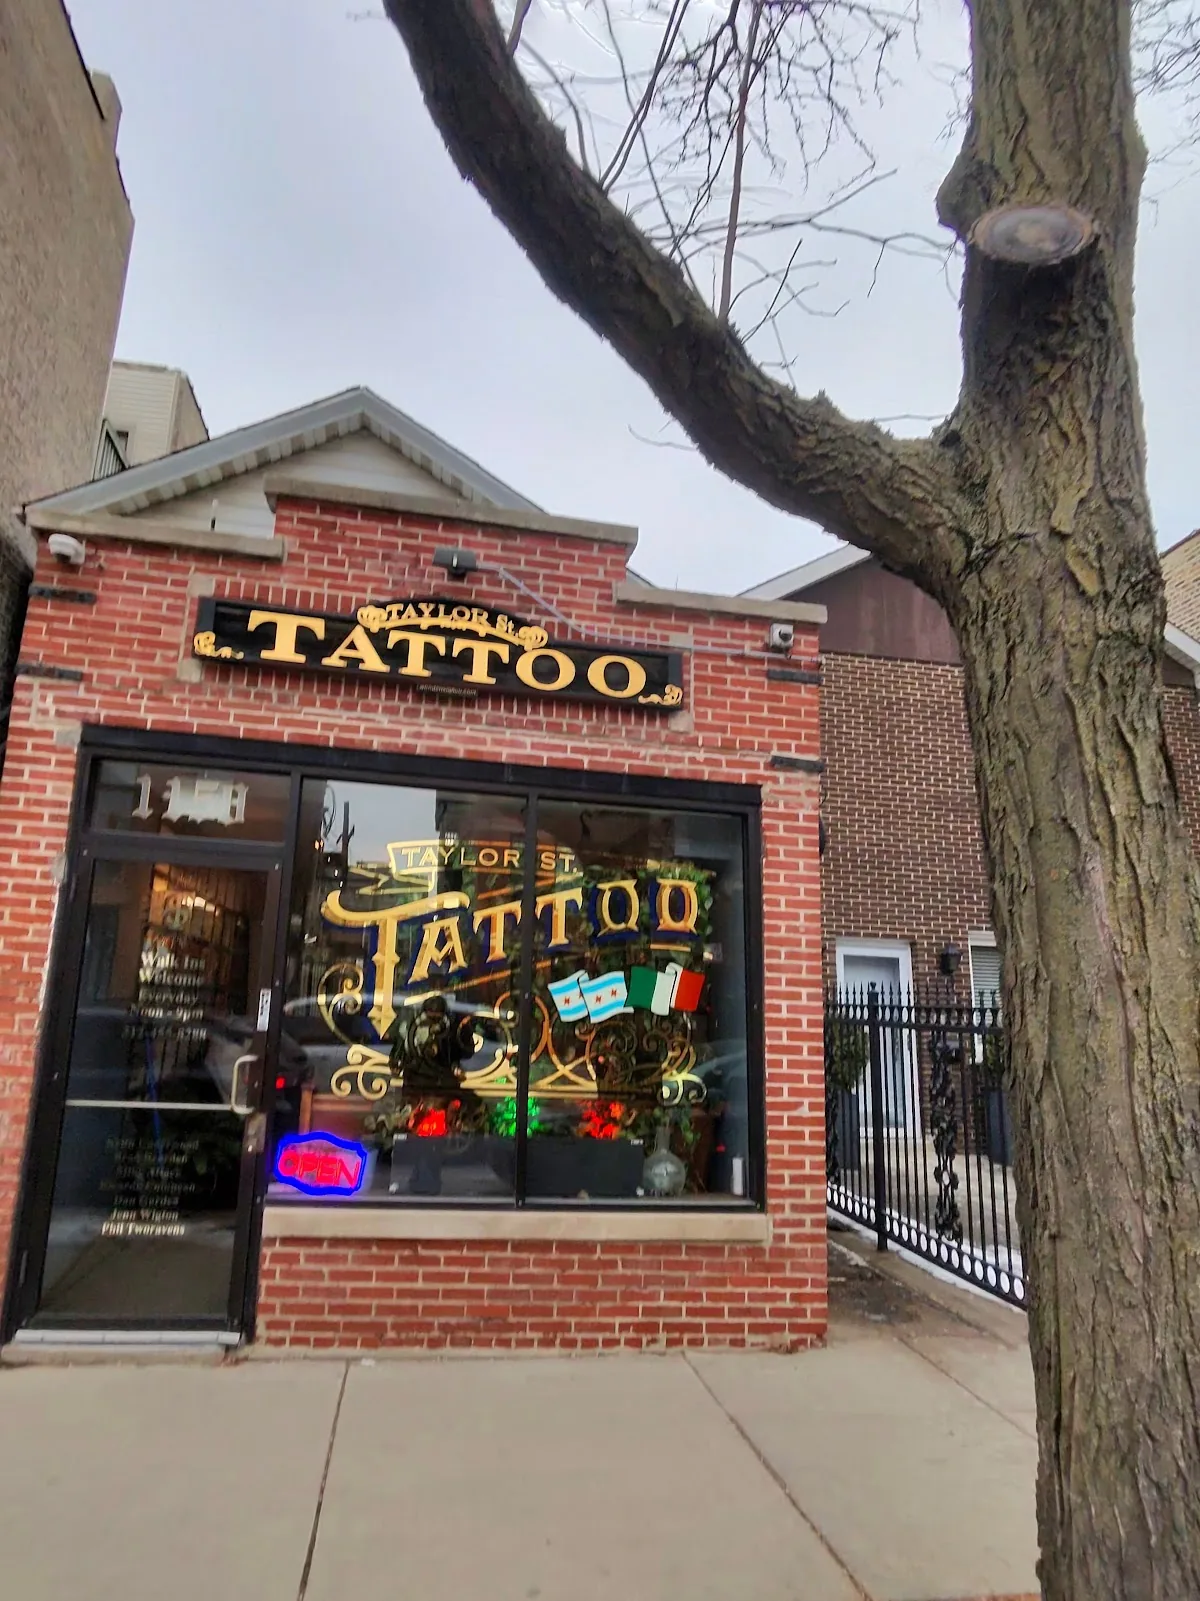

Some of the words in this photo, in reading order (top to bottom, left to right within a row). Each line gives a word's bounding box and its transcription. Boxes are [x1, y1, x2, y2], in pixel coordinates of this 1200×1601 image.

[385, 602, 492, 627] TAYLOR
[495, 613, 520, 638] St.
[247, 609, 648, 698] TATTOO
[401, 846, 521, 868] TAYLOR
[320, 878, 699, 1040] TATTOO
[139, 967, 204, 988] Welcome
[138, 987, 200, 1007] Everyday
[278, 1149, 361, 1189] OPEN
[101, 1222, 124, 1236] Phil
